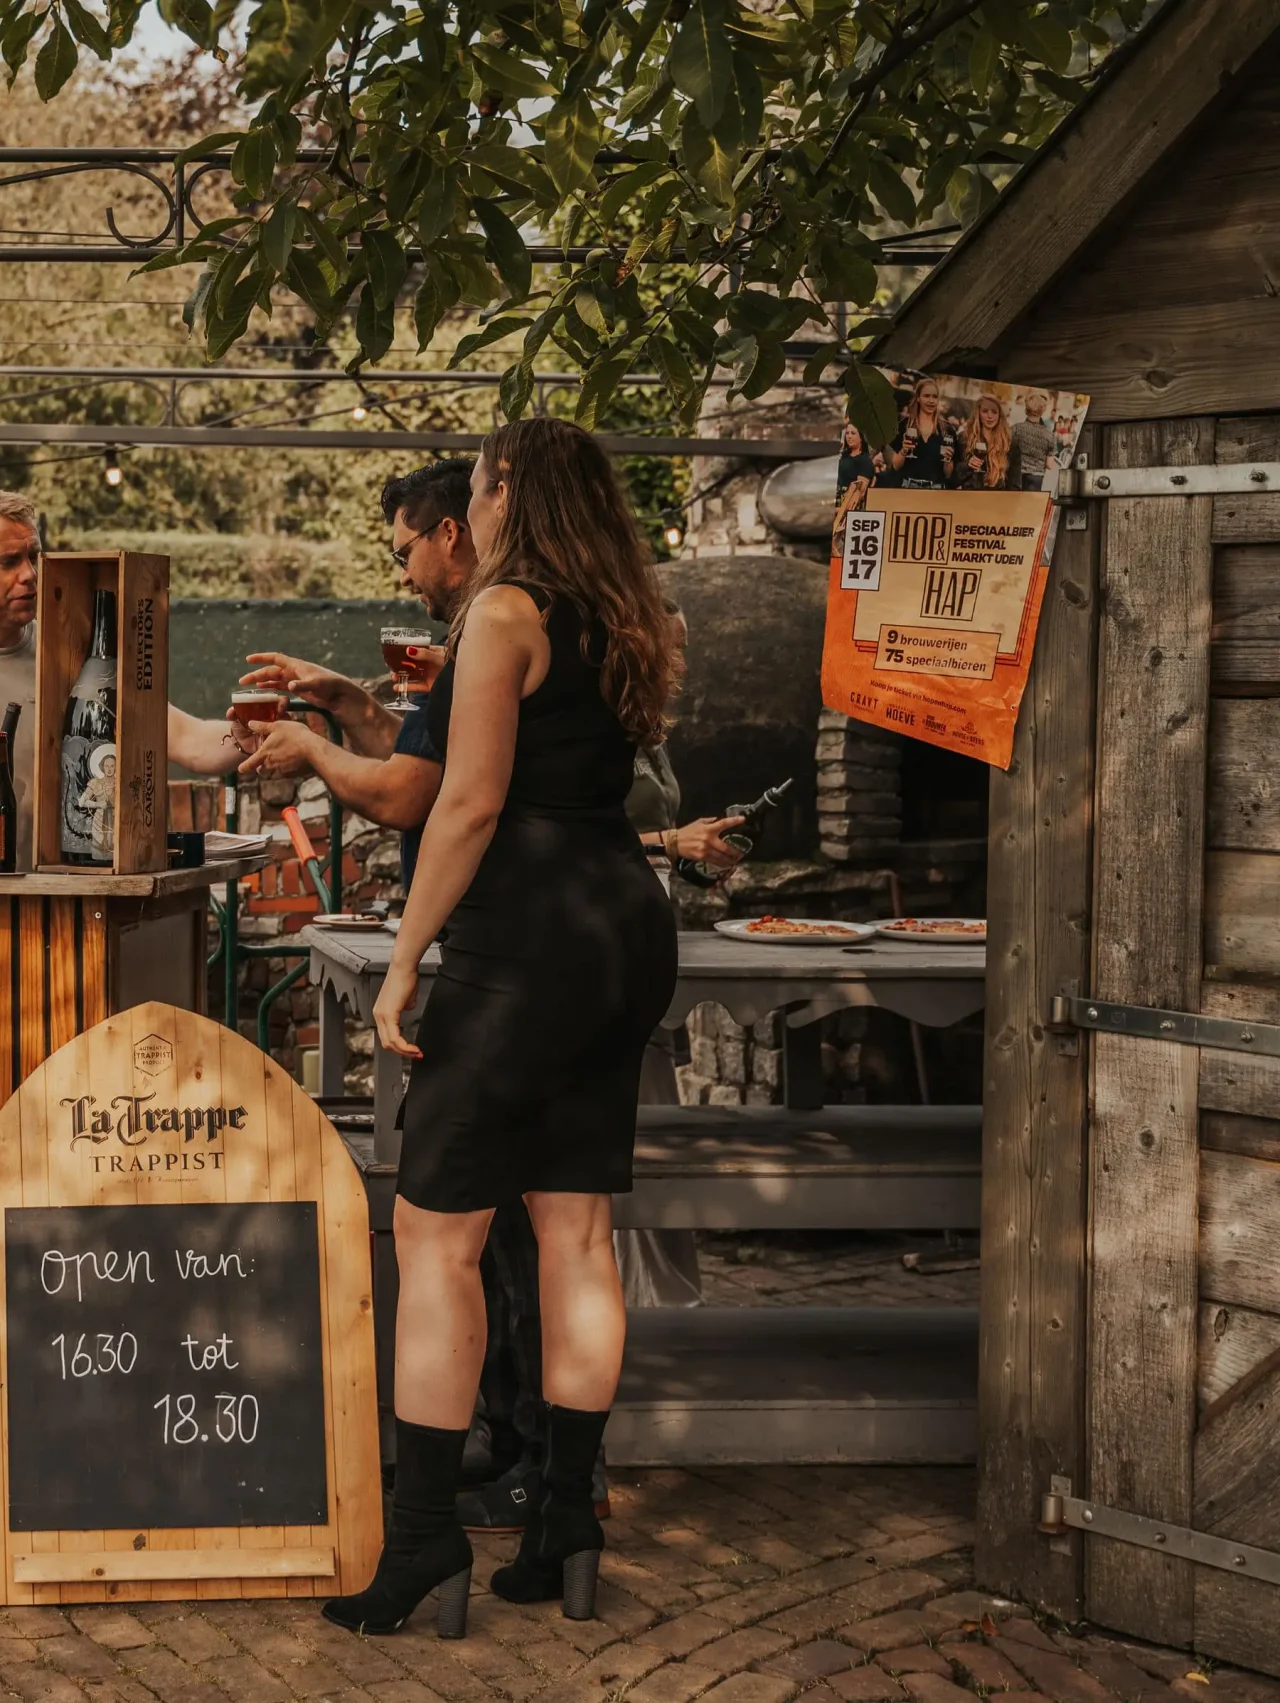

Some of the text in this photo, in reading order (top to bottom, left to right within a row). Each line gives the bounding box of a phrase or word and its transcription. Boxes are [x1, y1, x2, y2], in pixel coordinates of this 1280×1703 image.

[852, 519, 880, 532] SEP
[954, 524, 1035, 538] SPECIAALBIER
[850, 535, 879, 557] 16
[892, 515, 947, 561] HOP
[953, 538, 1007, 551] FESTIVAL
[848, 559, 877, 580] 17
[951, 552, 1024, 565] MARKT UDEN
[924, 570, 978, 617] HAP
[144, 598, 154, 690] EDITION
[887, 629, 968, 651] 9 brouwerijen
[885, 648, 987, 672] 75 speciaalbieren
[885, 707, 916, 727] HOEVE
[145, 750, 155, 828] CAROLUS
[136, 1051, 171, 1059] TRAPPIST
[59, 1091, 249, 1153] La Trappe
[89, 1151, 225, 1173] TRAPPIST
[51, 1332, 240, 1380] 16.30 tot
[153, 1393, 259, 1444] 18.30
